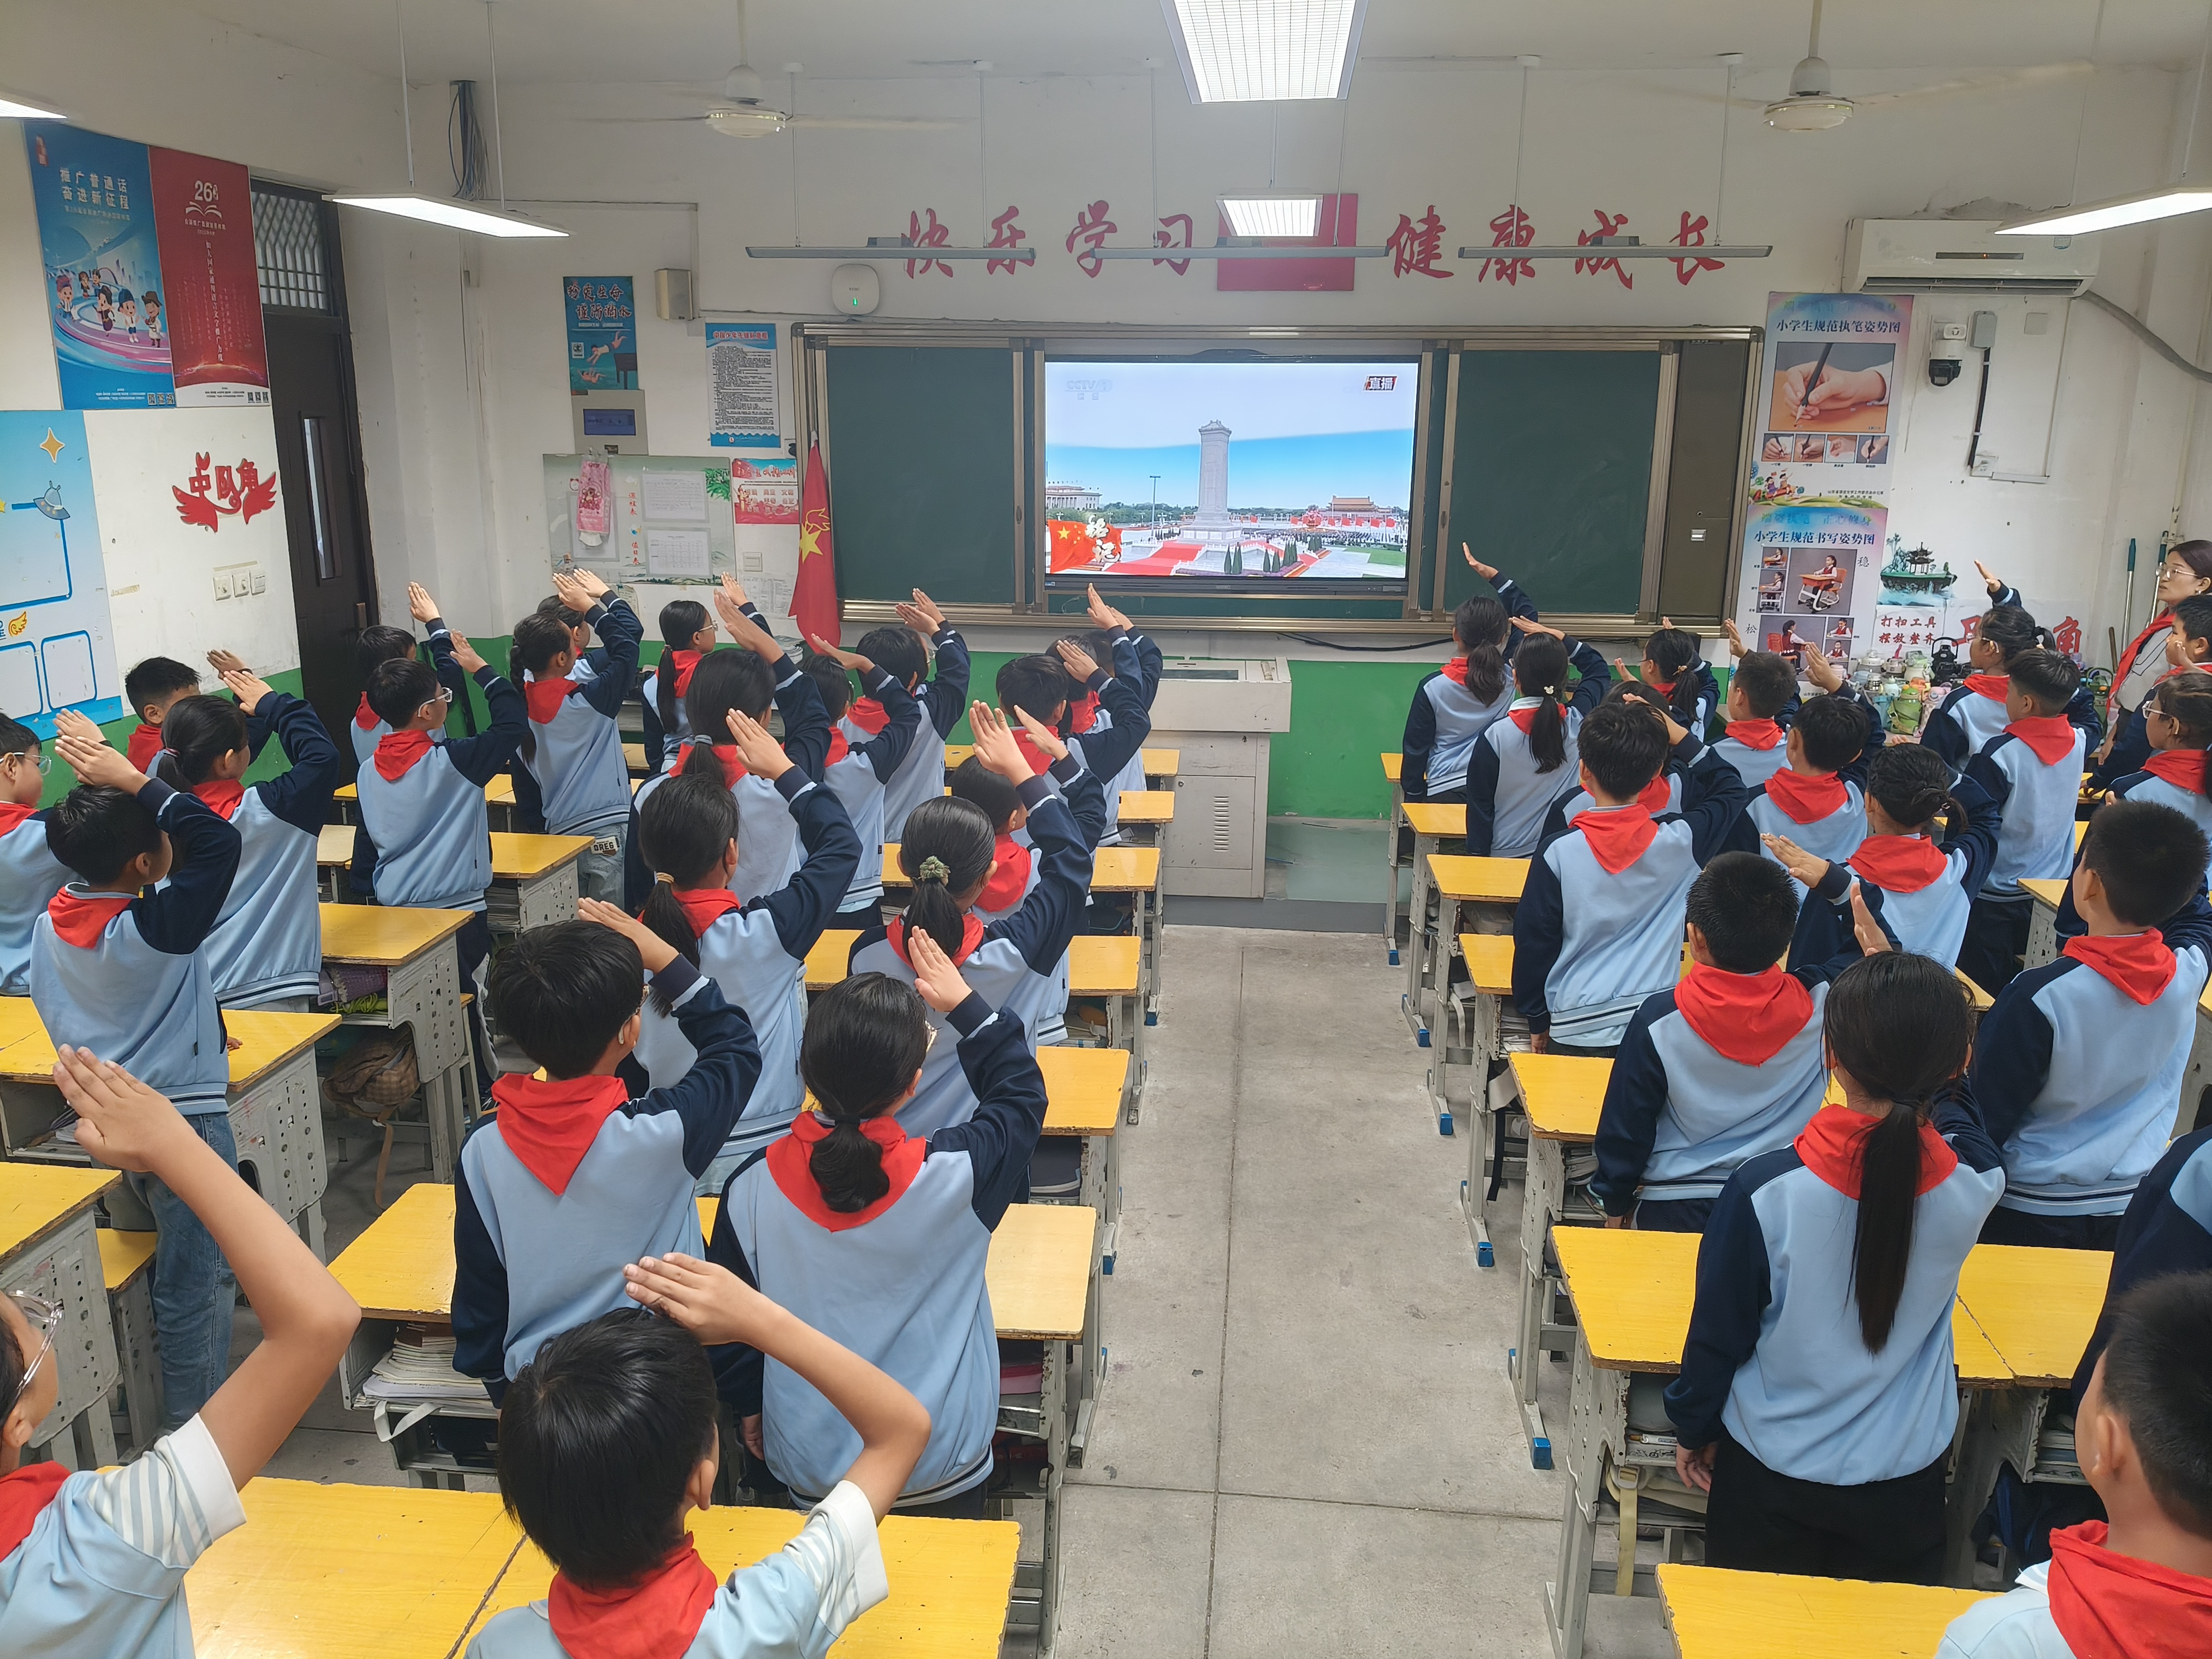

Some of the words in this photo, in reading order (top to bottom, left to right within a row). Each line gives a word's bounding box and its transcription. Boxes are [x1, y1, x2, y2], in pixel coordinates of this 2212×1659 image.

[60, 167, 127, 193] 推广普通话
[62, 186, 129, 210] 奋进新征程
[901, 200, 1192, 279] 快乐学习
[1386, 204, 1725, 289] 健康成长
[567, 283, 624, 301] 珍爱生命
[576, 302, 632, 321] 谨防溺水
[1776, 319, 1901, 333] 小学生规范执笔姿势图
[1369, 377, 1393, 390] 直播
[188, 458, 259, 500] 中队角
[1754, 530, 1875, 545] 小学生规范书写姿势图
[1857, 556, 1869, 567] 稳
[1745, 624, 1757, 634] 松
[1881, 615, 1936, 628] 打扫工具
[1879, 632, 1936, 645] 摆放整齐
